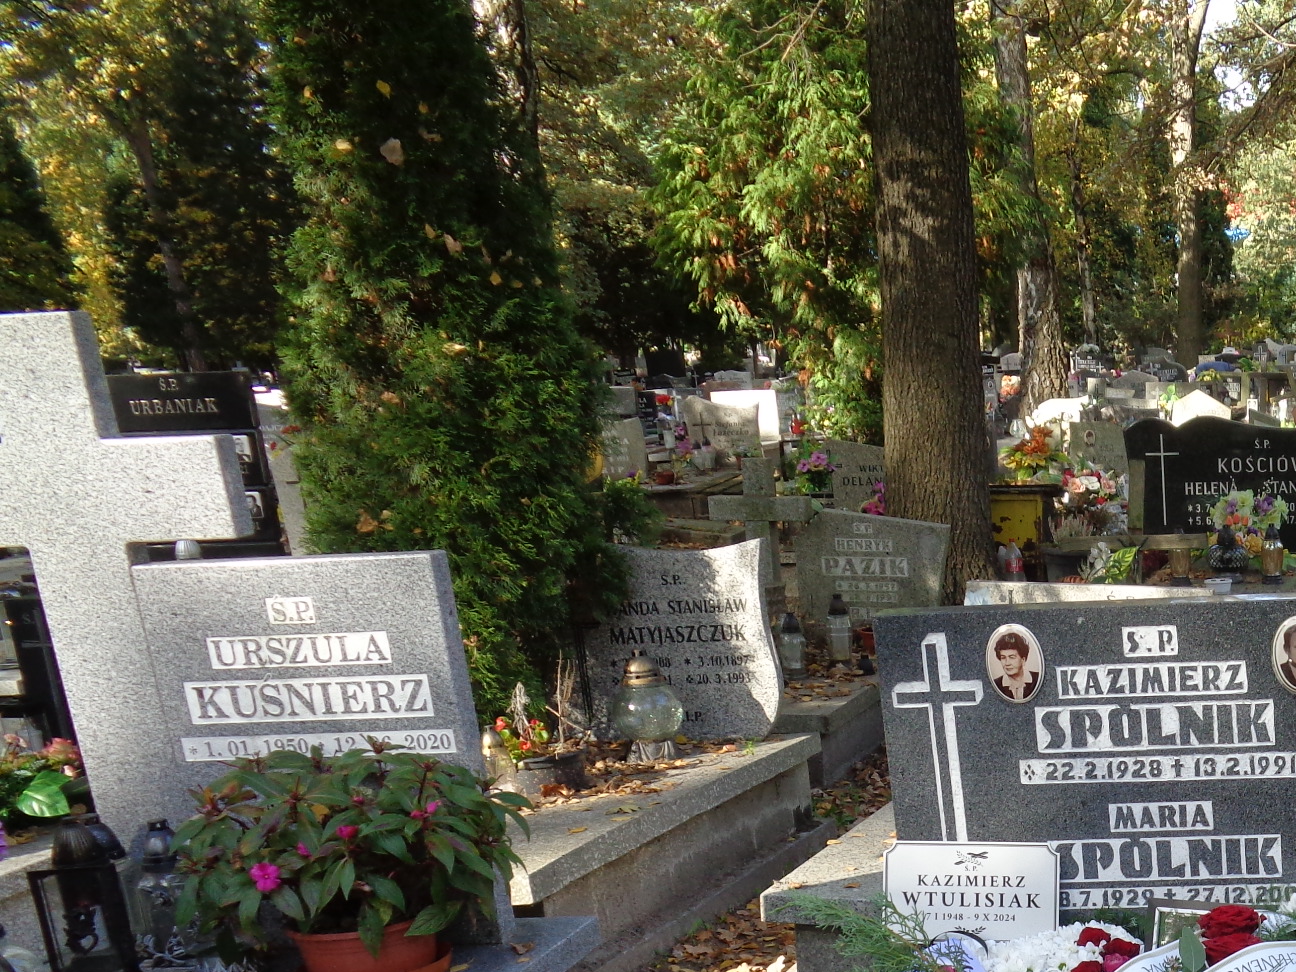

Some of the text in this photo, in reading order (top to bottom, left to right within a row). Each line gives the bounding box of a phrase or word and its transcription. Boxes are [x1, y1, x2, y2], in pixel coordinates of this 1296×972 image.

[129, 397, 219, 415] URBANIAK
[836, 538, 893, 552] HENRYK
[667, 599, 748, 615] STANISŁAW
[609, 623, 747, 645] MATYJASZCZUK
[210, 634, 389, 667] URSZULA
[1059, 663, 1246, 697] KAZIMIERZ
[191, 672, 429, 720] KUŚNIERZ
[1040, 702, 1275, 751] SPÓLNIK
[406, 733, 452, 751] 2020
[1045, 759, 1163, 781] 22.2.1928
[1193, 754, 1296, 778] 13.2.1991
[1112, 803, 1210, 831] MARIA
[1059, 837, 1280, 881] SPÓLNIK
[917, 874, 1026, 888] KAZIMIERZ
[902, 891, 1041, 908] WTULISIAK
[942, 912, 964, 921] 1948
[982, 913, 990, 921] X
[993, 913, 1016, 922] 2024
